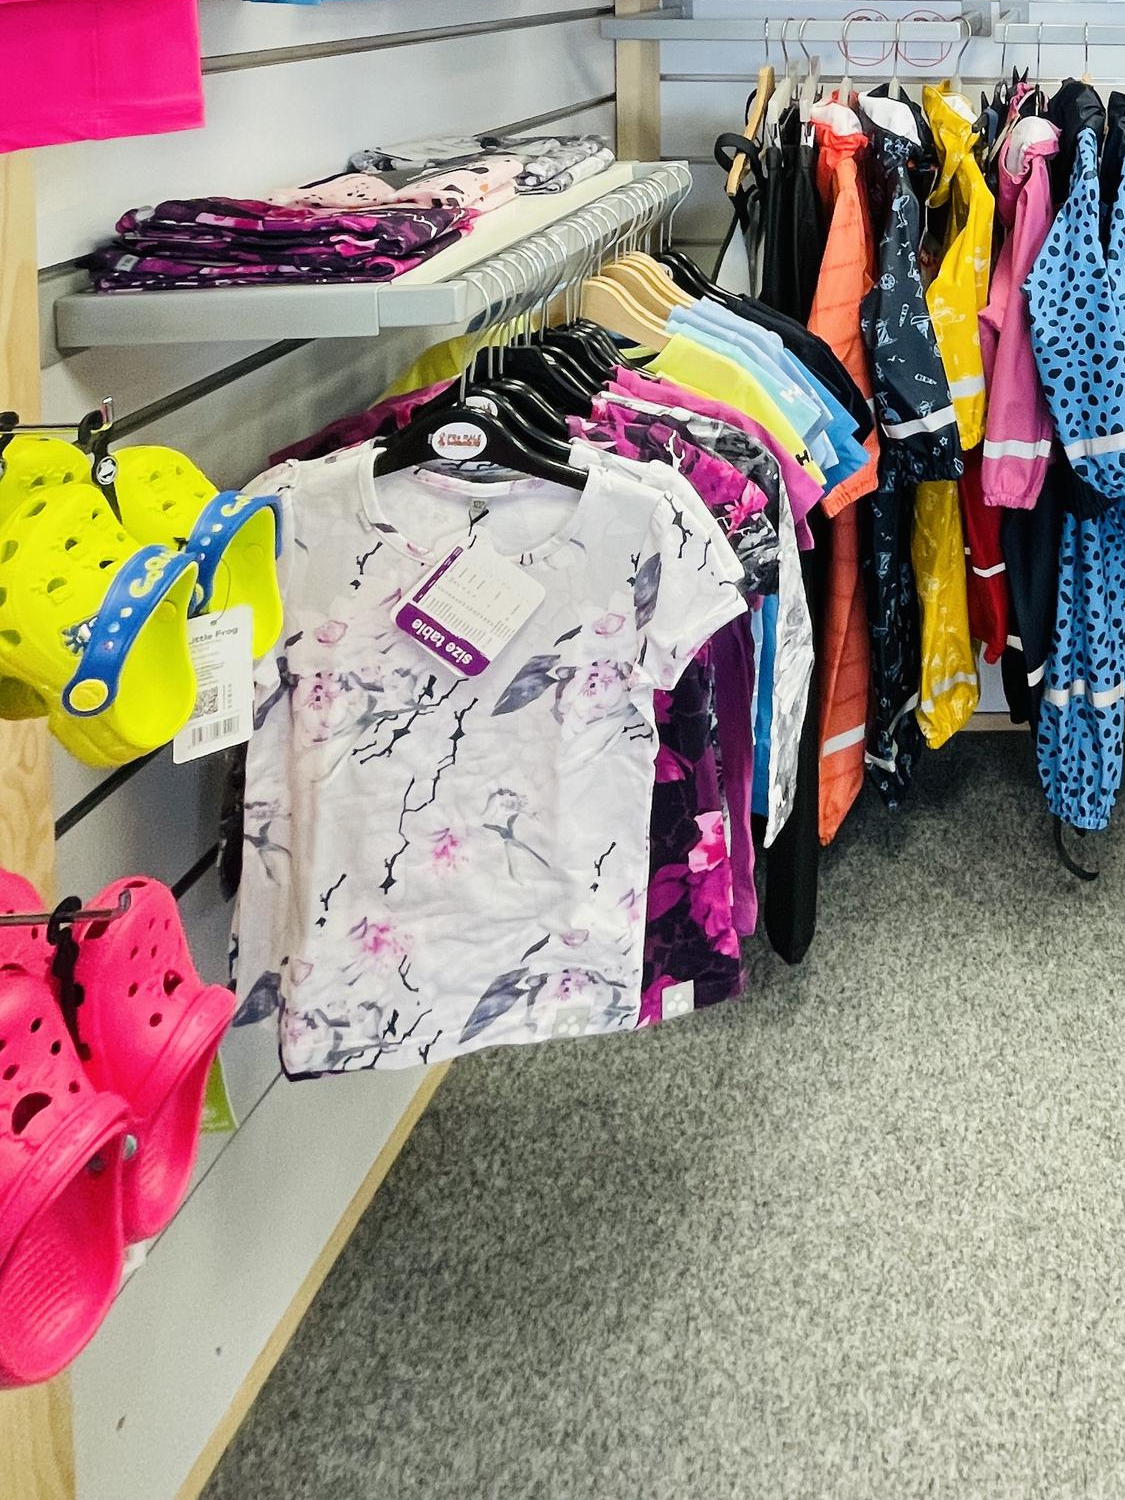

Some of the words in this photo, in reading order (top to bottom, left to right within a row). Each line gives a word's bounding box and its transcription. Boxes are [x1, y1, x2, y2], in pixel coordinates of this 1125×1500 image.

[215, 626, 238, 640] Frog
[411, 617, 446, 648] table
[445, 641, 473, 665] size
